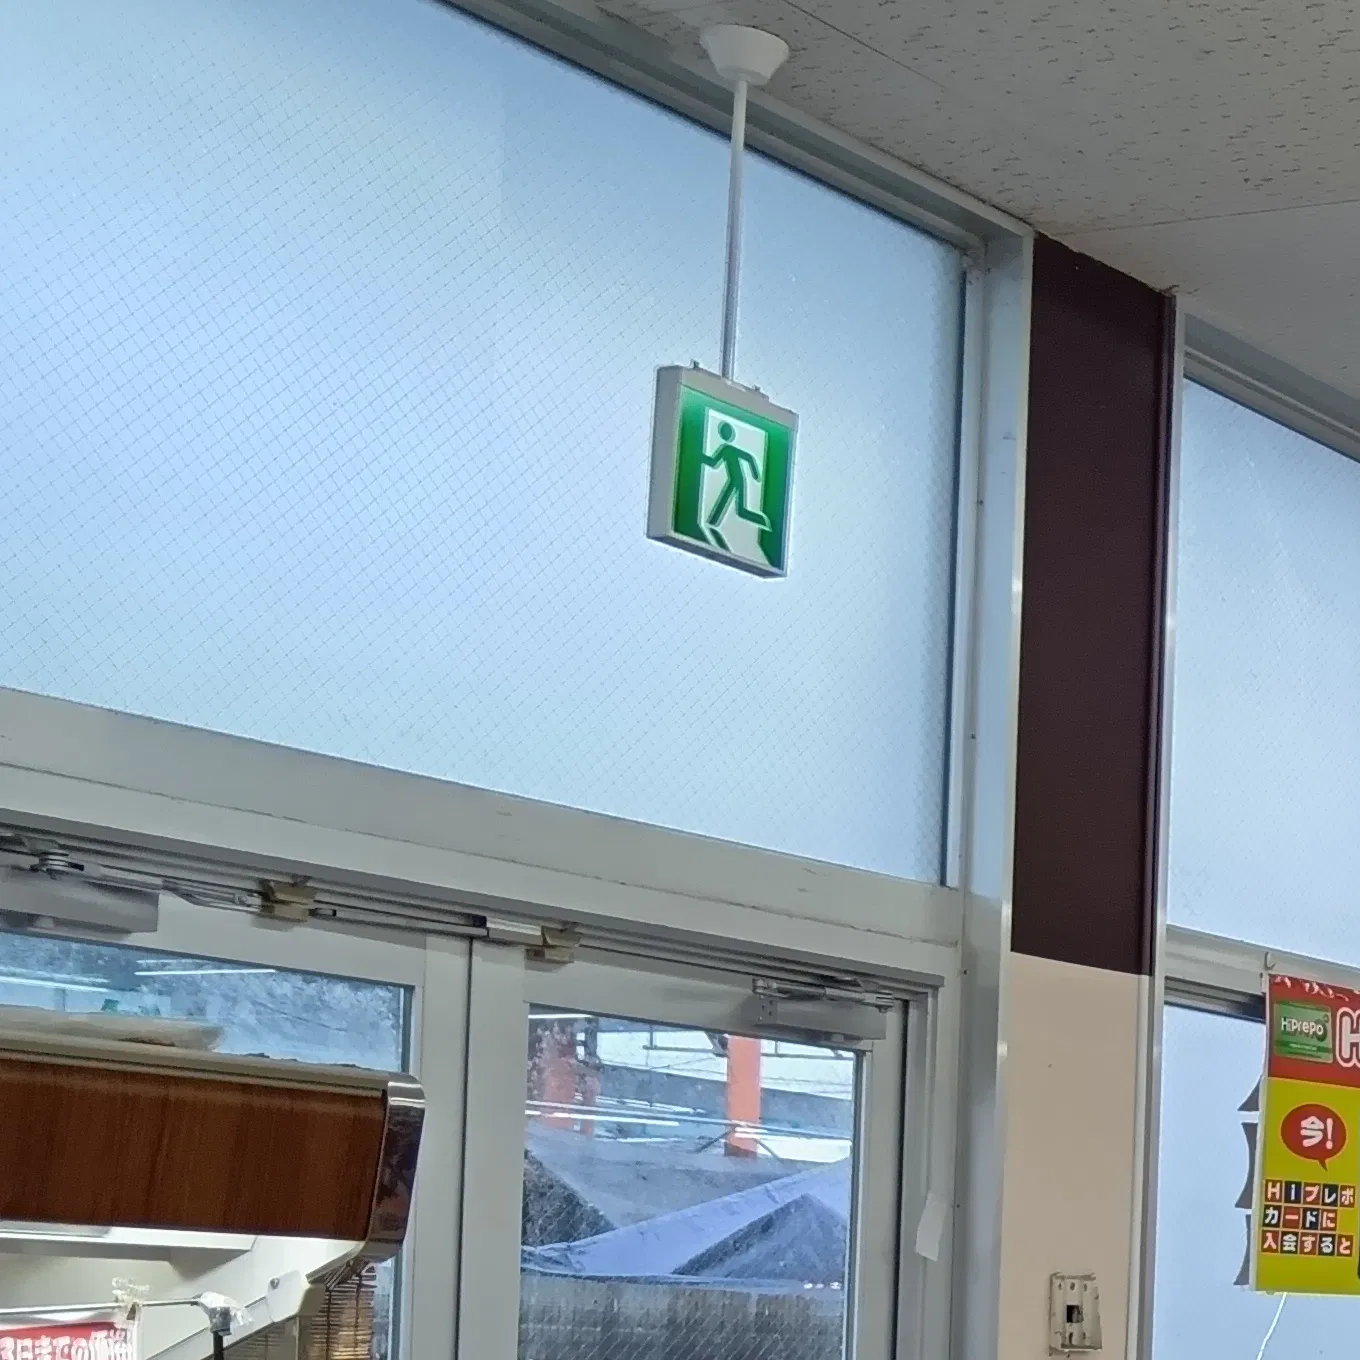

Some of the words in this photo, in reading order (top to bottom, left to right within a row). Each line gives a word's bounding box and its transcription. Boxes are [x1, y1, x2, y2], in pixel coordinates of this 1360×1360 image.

[1264, 1207, 1336, 1227] カードに
[1263, 1232, 1351, 1255] 入会すると
